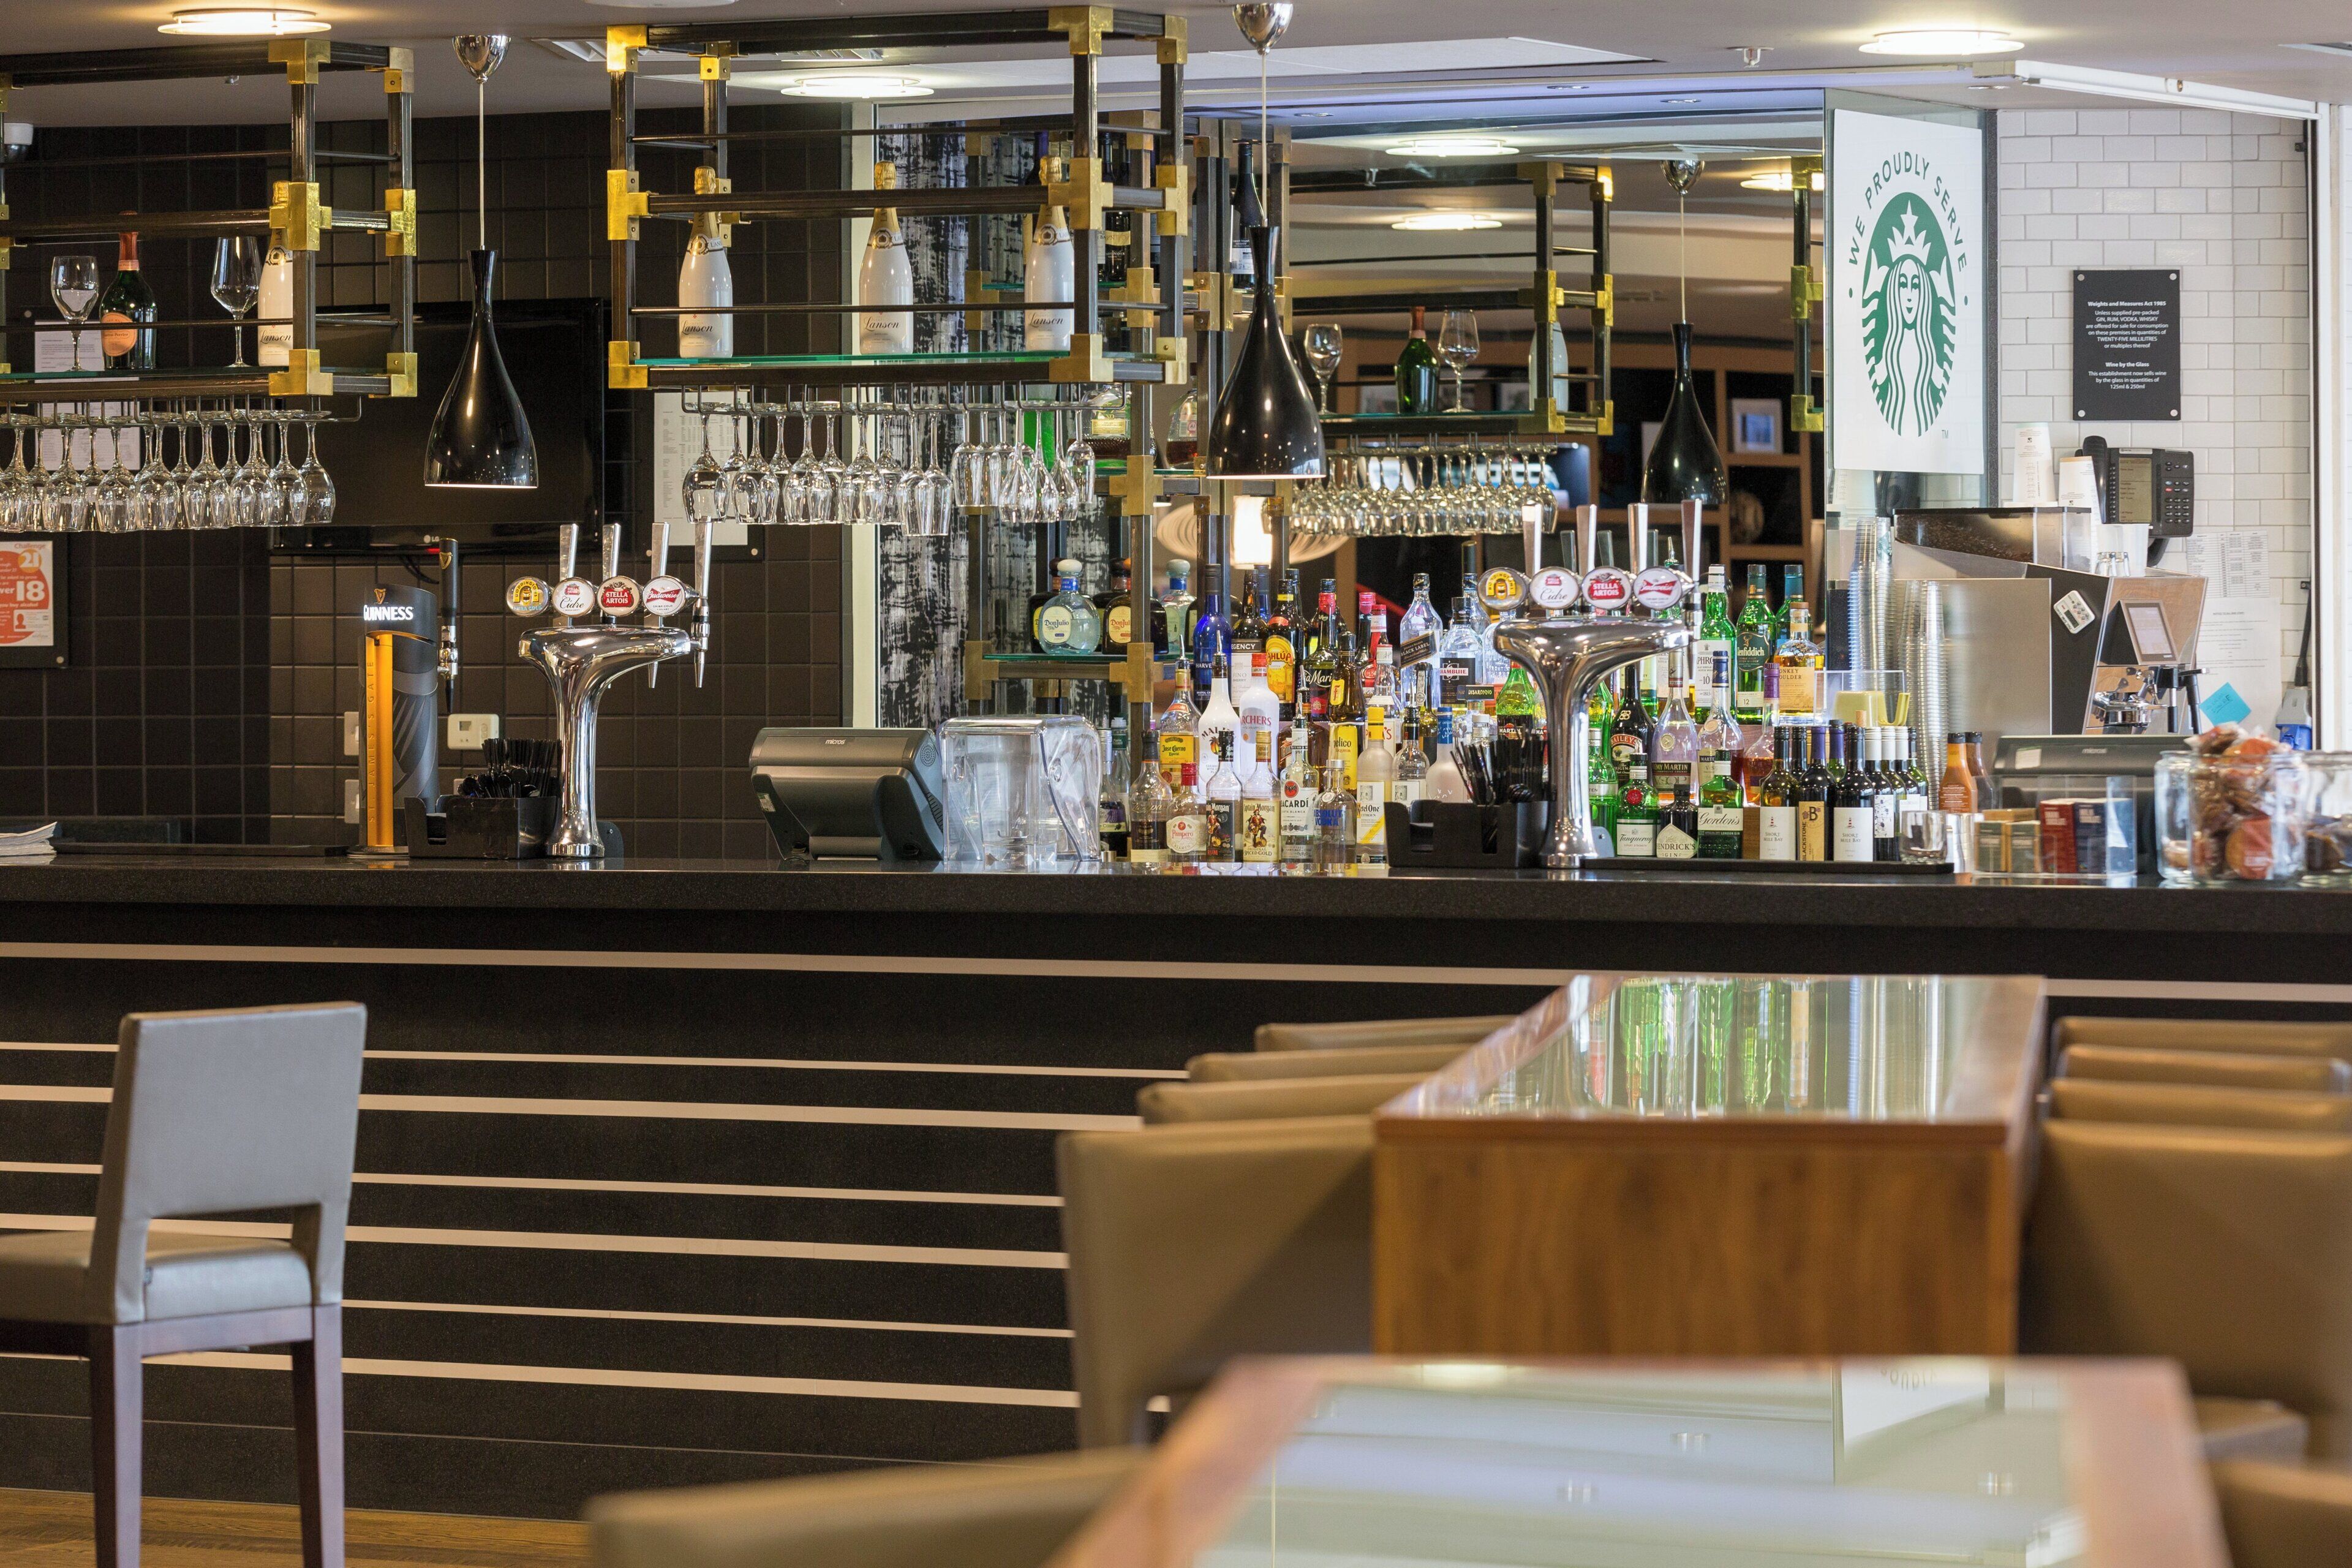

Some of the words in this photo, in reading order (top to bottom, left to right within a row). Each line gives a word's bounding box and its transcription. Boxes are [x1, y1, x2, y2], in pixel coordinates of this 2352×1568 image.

[1849, 216, 1866, 266] WE
[1865, 151, 1931, 210] PROUDLY
[1934, 175, 1967, 274] SERVE
[864, 315, 900, 332] Lanson
[1028, 312, 1065, 328] Lanson
[681, 320, 713, 336] Lanson
[260, 329, 292, 345] Lanson
[20, 551, 39, 568] 21
[16, 581, 46, 601] 18
[646, 590, 681, 600] Budweiser
[1540, 587, 1568, 600] Cidre
[559, 595, 584, 609] Cidre
[1110, 619, 1131, 628] DonJul
[1415, 641, 1430, 651] LABEL
[1738, 647, 1765, 657] lenfiddich
[1267, 652, 1293, 664] AHLÚA
[1309, 669, 1333, 685] Mari
[1703, 676, 1710, 685] 10
[1333, 736, 1352, 748] gelico
[1610, 735, 1637, 745] BAILEYS
[1162, 745, 1172, 753] Jose
[1210, 802, 1230, 813] Morgan
[1256, 803, 1275, 813] Morgan
[1313, 809, 1343, 818] ABSOLUT
[1809, 806, 1819, 821] B
[1314, 818, 1340, 826] VODKA
[1698, 812, 1741, 826] Gordon's
[1171, 829, 1194, 840] Pampero
[1619, 834, 1654, 844] Tanqueray
